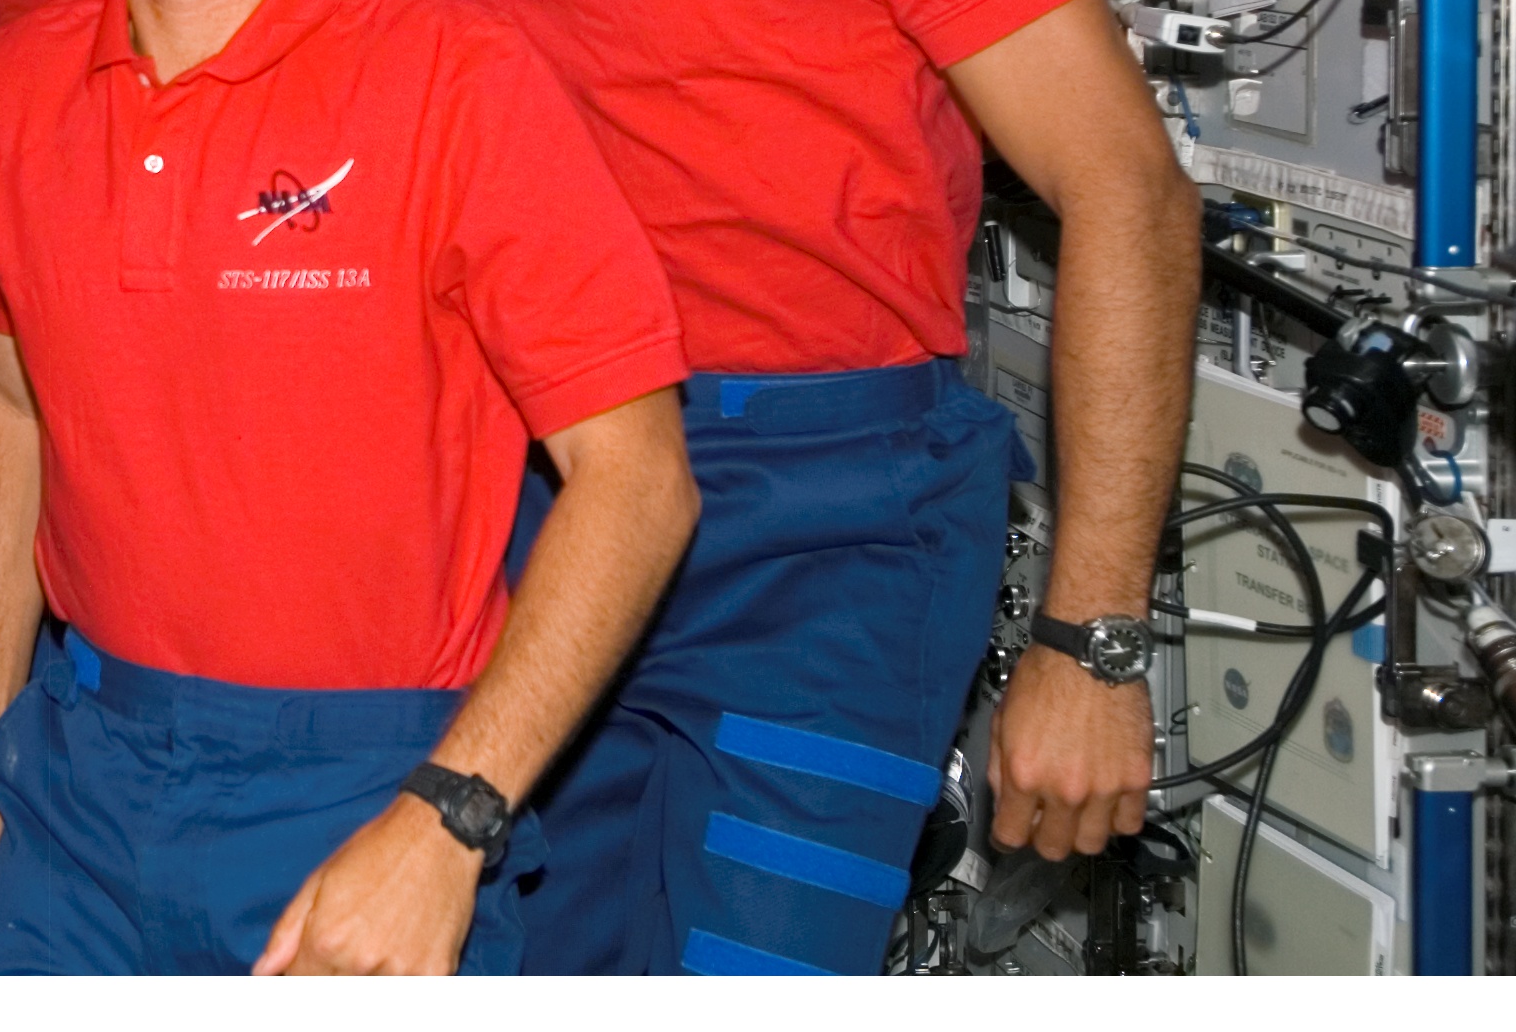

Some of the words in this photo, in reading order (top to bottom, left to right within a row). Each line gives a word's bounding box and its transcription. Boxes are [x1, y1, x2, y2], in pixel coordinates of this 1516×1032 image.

[217, 269, 331, 289] STS-117/ISS
[336, 268, 371, 288] 13A
[1310, 546, 1349, 573] SPACE
[1235, 572, 1295, 609] TRANSFER
